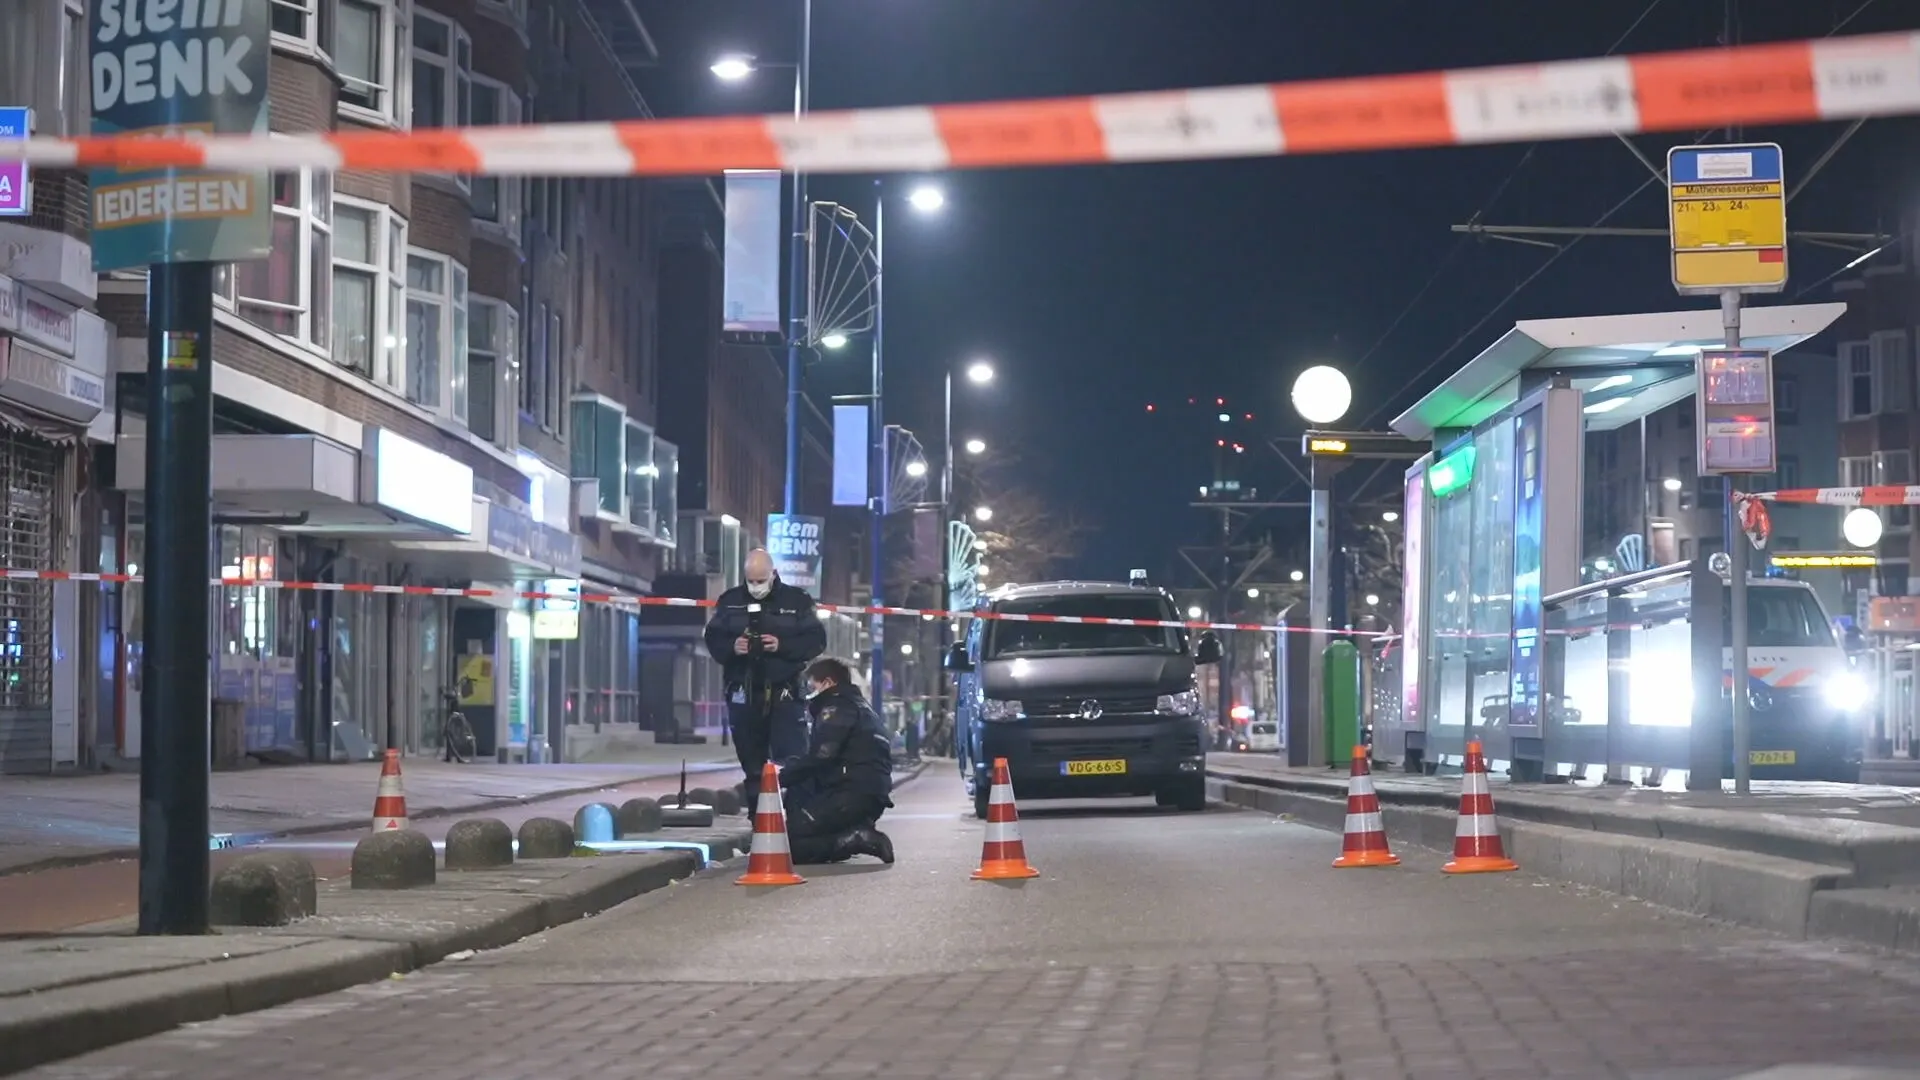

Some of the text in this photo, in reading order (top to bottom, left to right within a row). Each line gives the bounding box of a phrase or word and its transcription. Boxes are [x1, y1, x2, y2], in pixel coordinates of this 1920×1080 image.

[92, 36, 253, 111] DENK
[1686, 183, 1769, 194] Mathenesserplein
[96, 180, 248, 223] IEDEREEN
[1678, 201, 1743, 213] 21 23 24
[771, 519, 819, 538] stem
[768, 537, 820, 556] DENK
[1068, 761, 1123, 773] VDG-66-S
